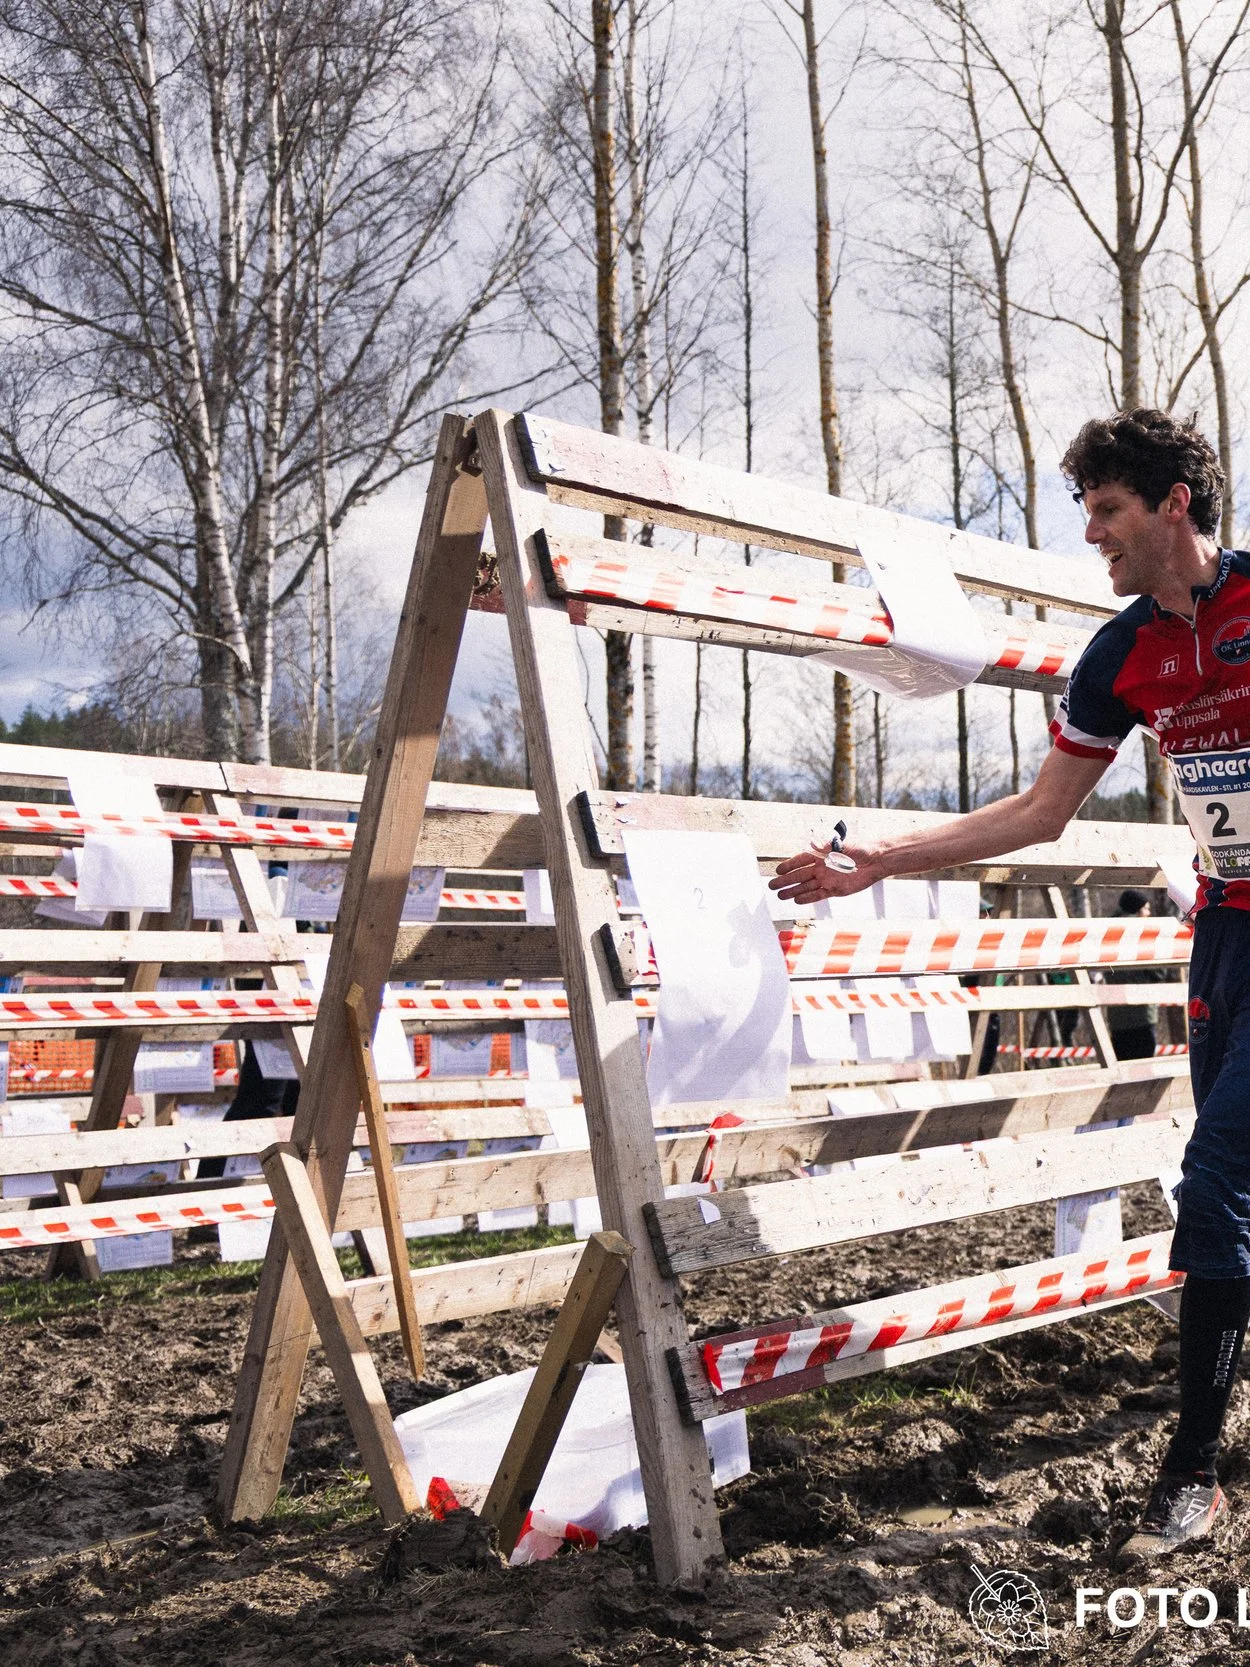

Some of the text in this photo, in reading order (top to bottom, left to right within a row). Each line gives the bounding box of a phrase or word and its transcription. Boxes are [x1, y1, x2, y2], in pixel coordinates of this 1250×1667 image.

[1220, 644, 1232, 653] OK
[1176, 707, 1220, 729] Uppsala
[1206, 802, 1237, 838] 2
[693, 887, 708, 910] 2
